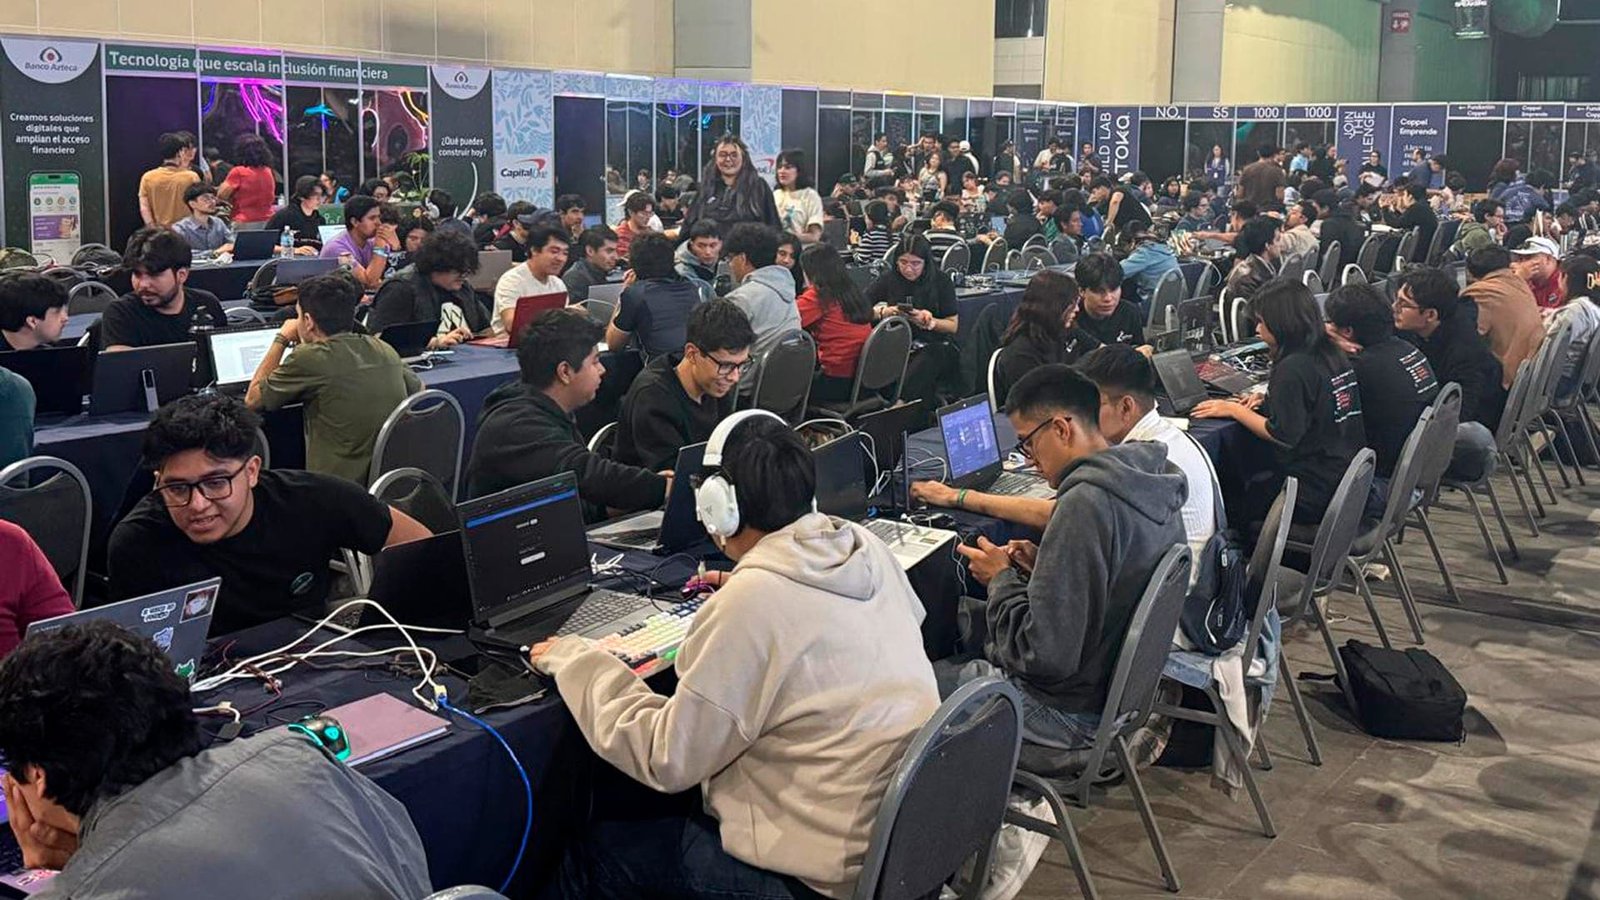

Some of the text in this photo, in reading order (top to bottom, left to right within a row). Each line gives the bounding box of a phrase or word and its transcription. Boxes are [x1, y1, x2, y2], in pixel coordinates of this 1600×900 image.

[24, 62, 78, 72] Banco Azteca
[109, 51, 389, 79] Tecnología que escala inclusión financiera
[9, 112, 94, 122] Creamos soluciones
[1253, 107, 1280, 118] 1000
[1304, 106, 1332, 118] 1000
[1343, 111, 1355, 140] JOIN
[1354, 111, 1365, 135] THE
[1400, 118, 1428, 127] Coppel
[25, 123, 80, 134] digitales que
[1400, 128, 1438, 136] Emprende
[52, 134, 60, 143] el
[62, 135, 90, 144] acceso
[441, 136, 484, 147] ¿Qué puedes
[1099, 112, 1111, 174] UILD LAB
[1362, 111, 1376, 165] LENGE
[32, 145, 75, 155] financiero
[438, 148, 487, 158] construir hoy?
